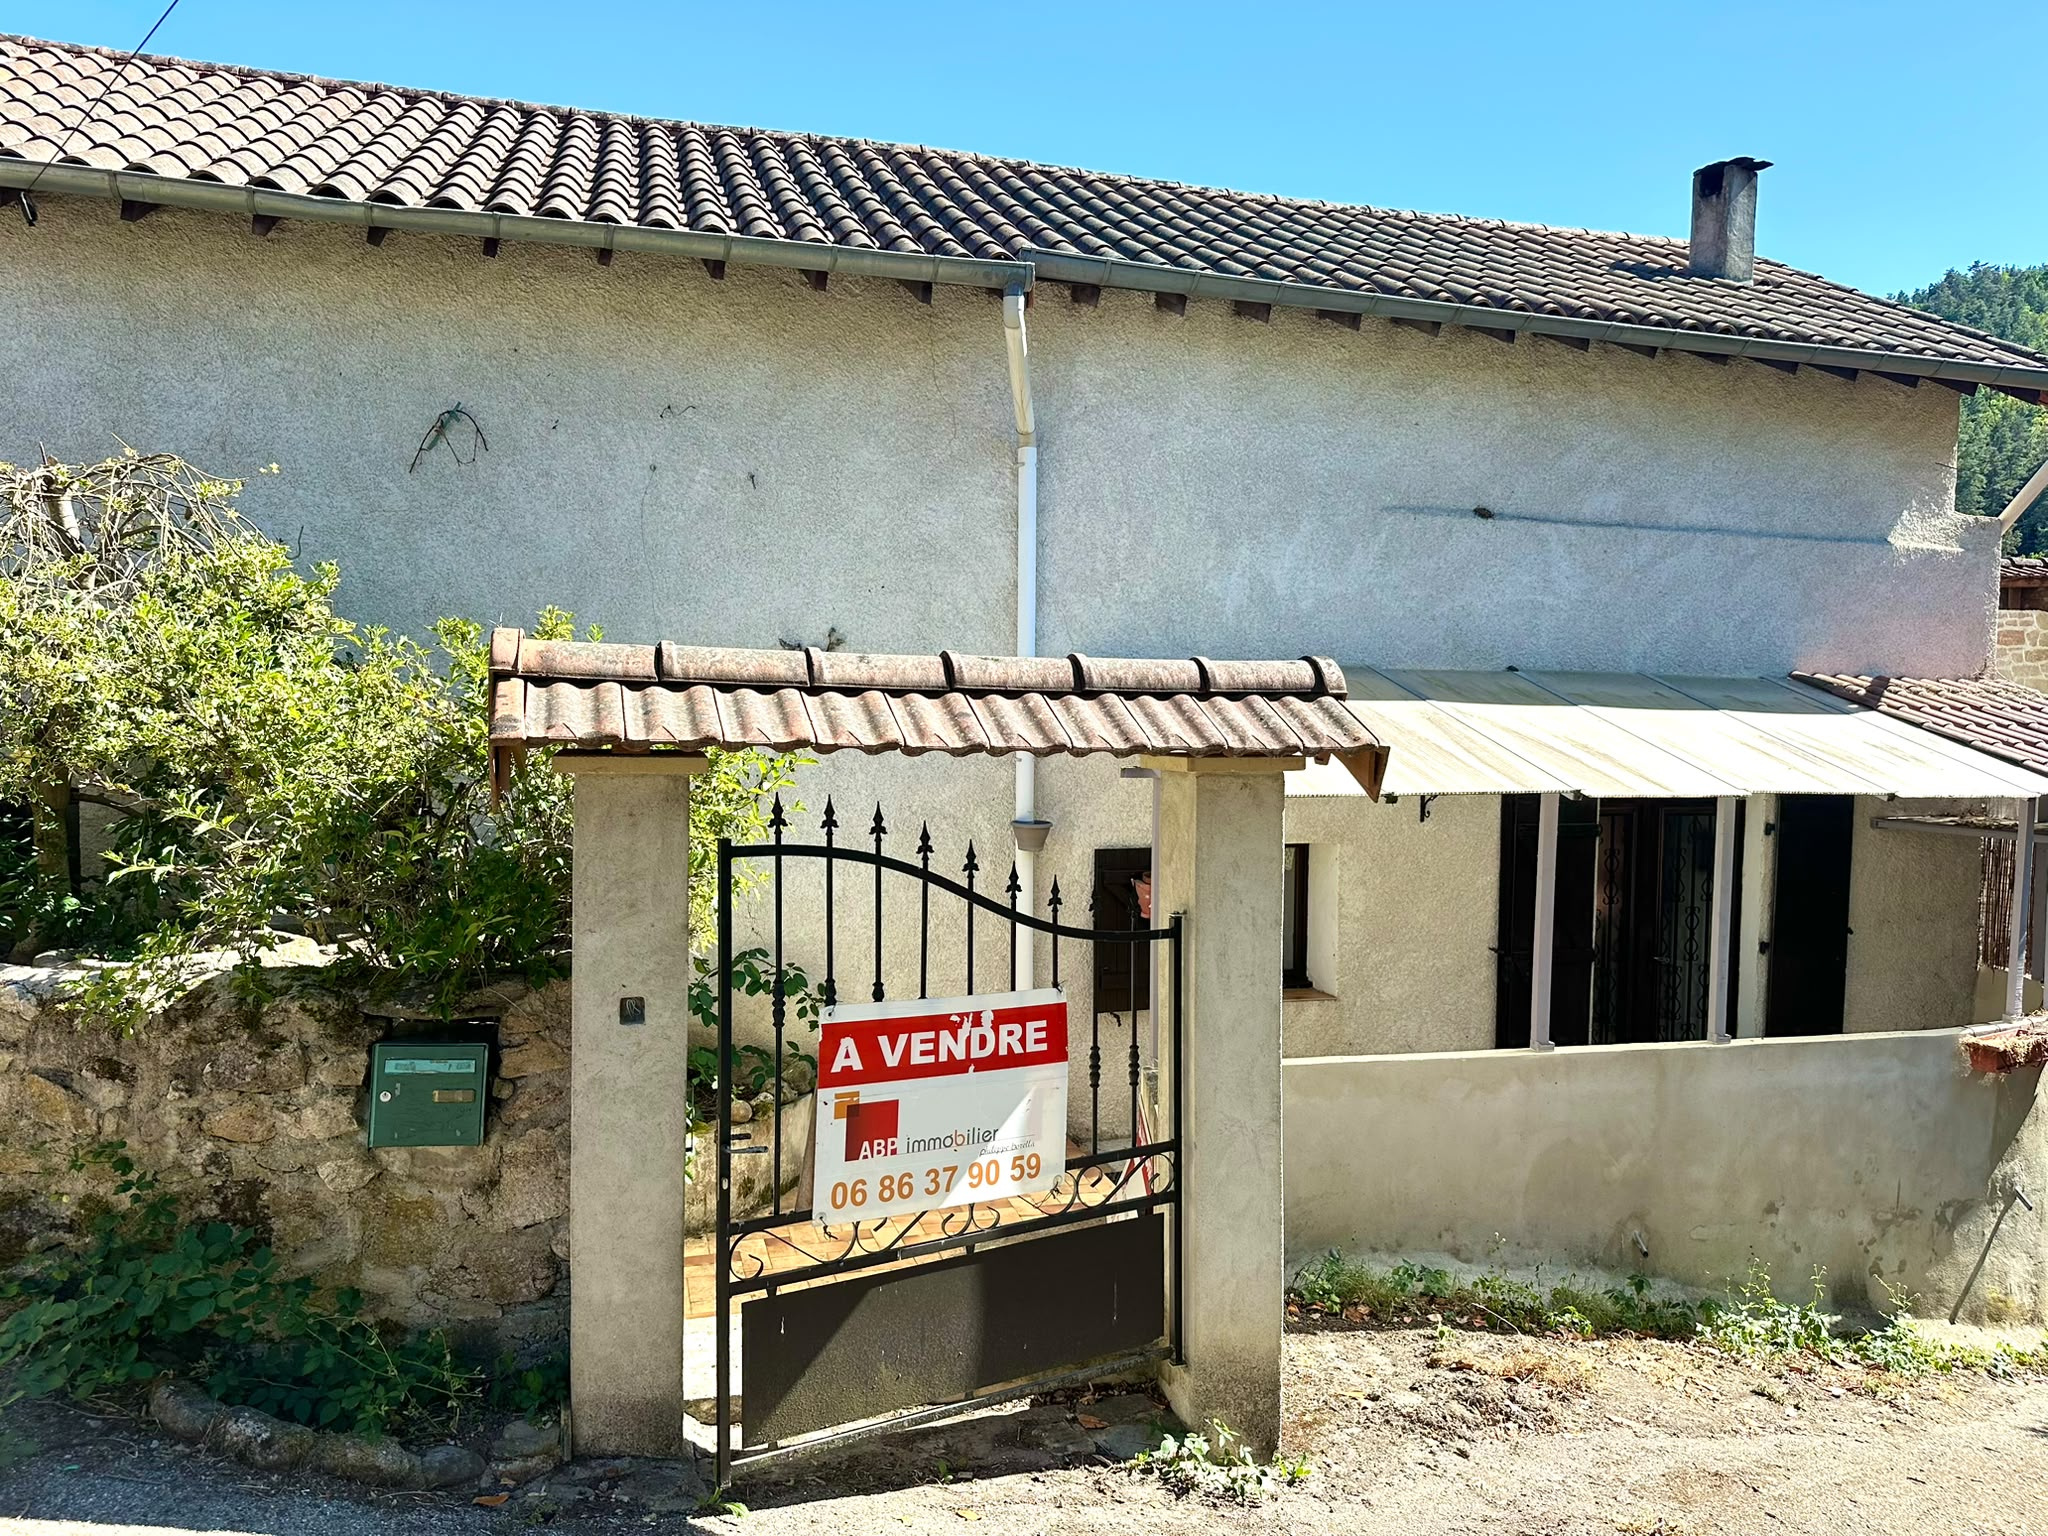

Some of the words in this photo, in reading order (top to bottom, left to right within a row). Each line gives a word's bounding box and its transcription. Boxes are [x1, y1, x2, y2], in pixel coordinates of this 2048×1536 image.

[831, 1037, 863, 1073] A
[878, 1020, 1048, 1067] VENDRE
[858, 1137, 897, 1160] ABP
[906, 1126, 998, 1153] immobilier
[830, 1179, 867, 1210] 06
[878, 1172, 914, 1203] 86
[924, 1165, 958, 1196] 37
[968, 1159, 1000, 1188] 90
[1010, 1153, 1041, 1182] 59
